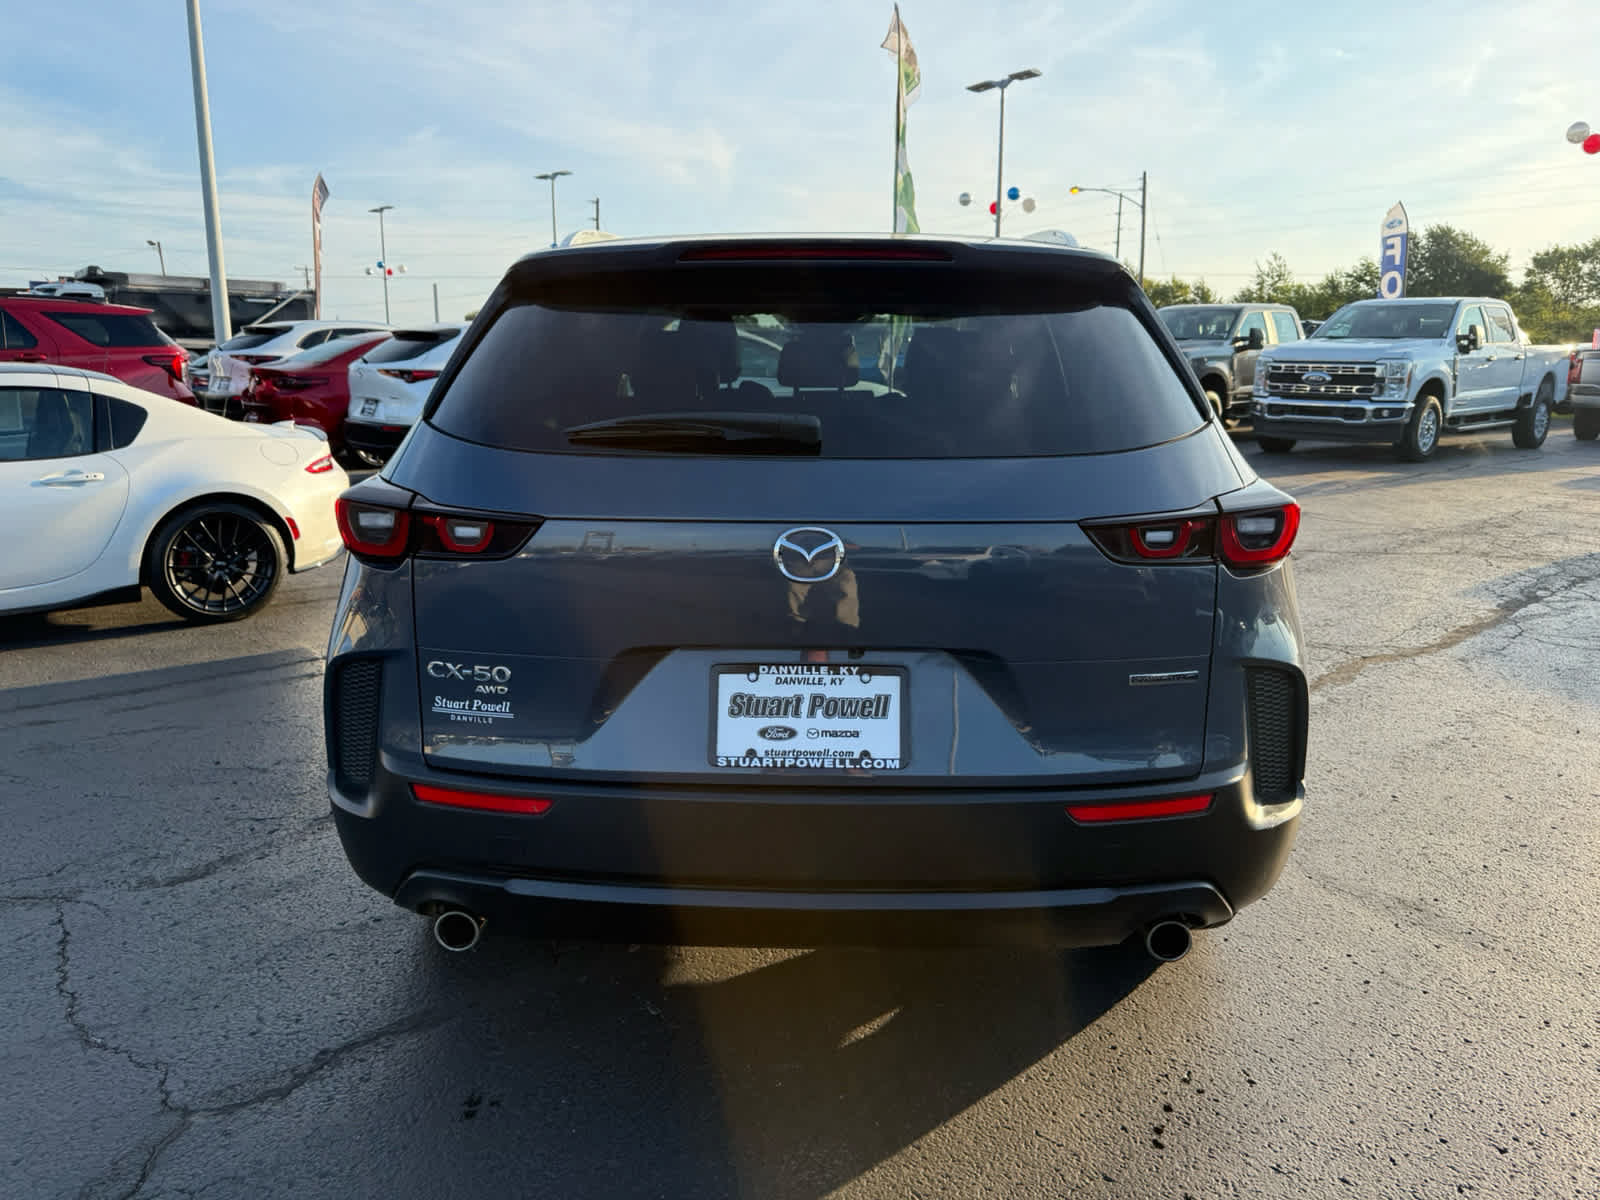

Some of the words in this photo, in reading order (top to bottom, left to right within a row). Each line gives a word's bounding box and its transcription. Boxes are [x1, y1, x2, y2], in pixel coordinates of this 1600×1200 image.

[427, 661, 512, 682] CX-50
[759, 665, 833, 675] DANVILLE,
[839, 666, 860, 675] KY
[775, 676, 827, 686] DANVILLE,
[830, 677, 845, 686] KY
[475, 685, 508, 694] AWD
[434, 696, 470, 709] Stuart
[472, 699, 511, 712] Powell
[728, 692, 804, 718] Stuart
[806, 694, 892, 719] Powell
[450, 714, 493, 724] DANVILLE
[764, 727, 792, 739] Ford
[820, 730, 860, 738] mazda
[764, 748, 854, 758] stuartpowell.com
[717, 757, 900, 769] STUARTPOWELL.COM
